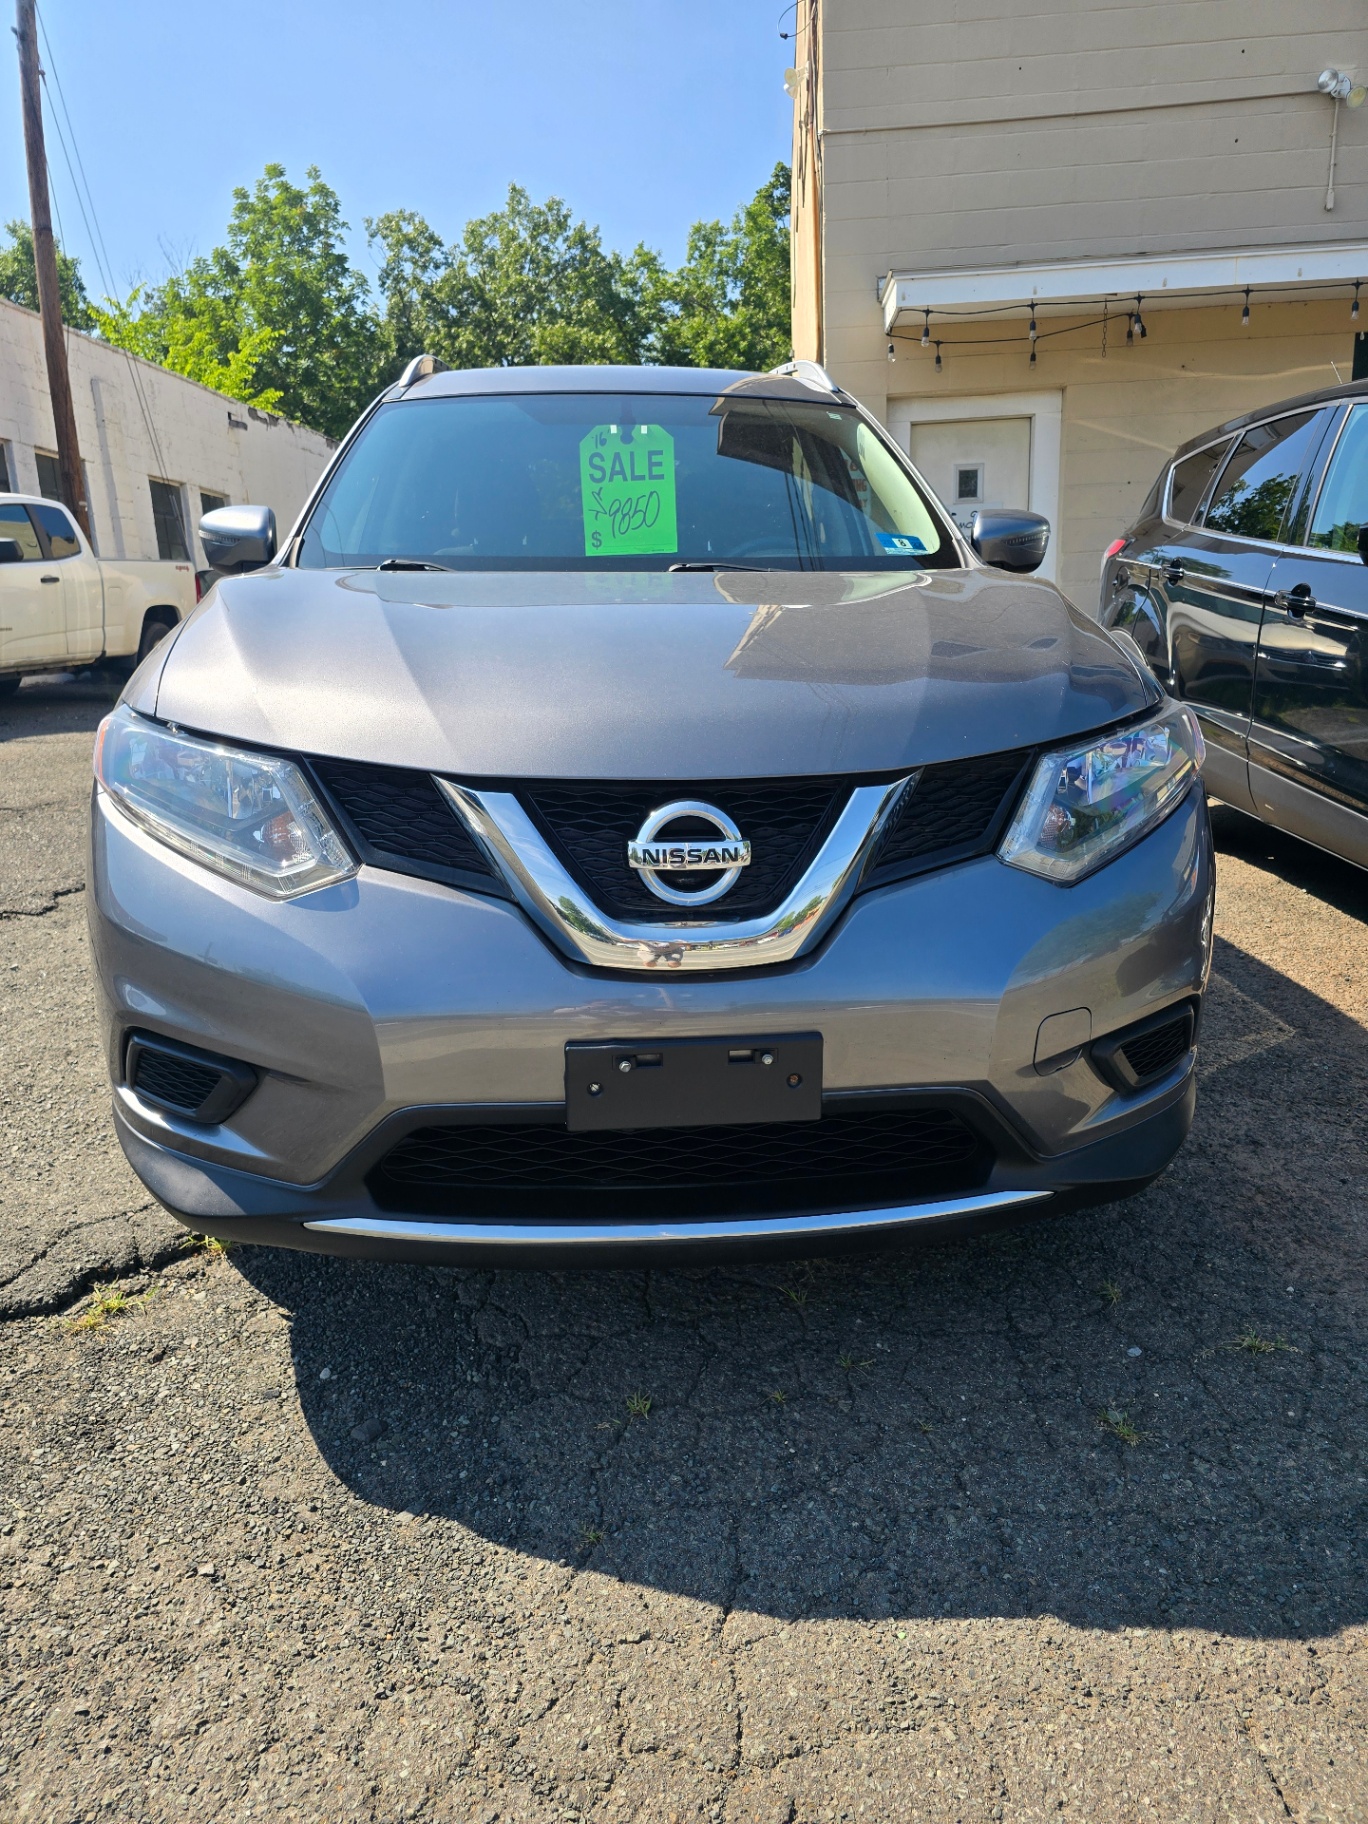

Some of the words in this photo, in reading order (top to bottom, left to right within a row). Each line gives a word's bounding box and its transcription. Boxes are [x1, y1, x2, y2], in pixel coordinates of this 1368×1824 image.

[588, 449, 665, 484] SALE
[591, 530, 603, 550] $
[642, 847, 739, 864] NISSAN
